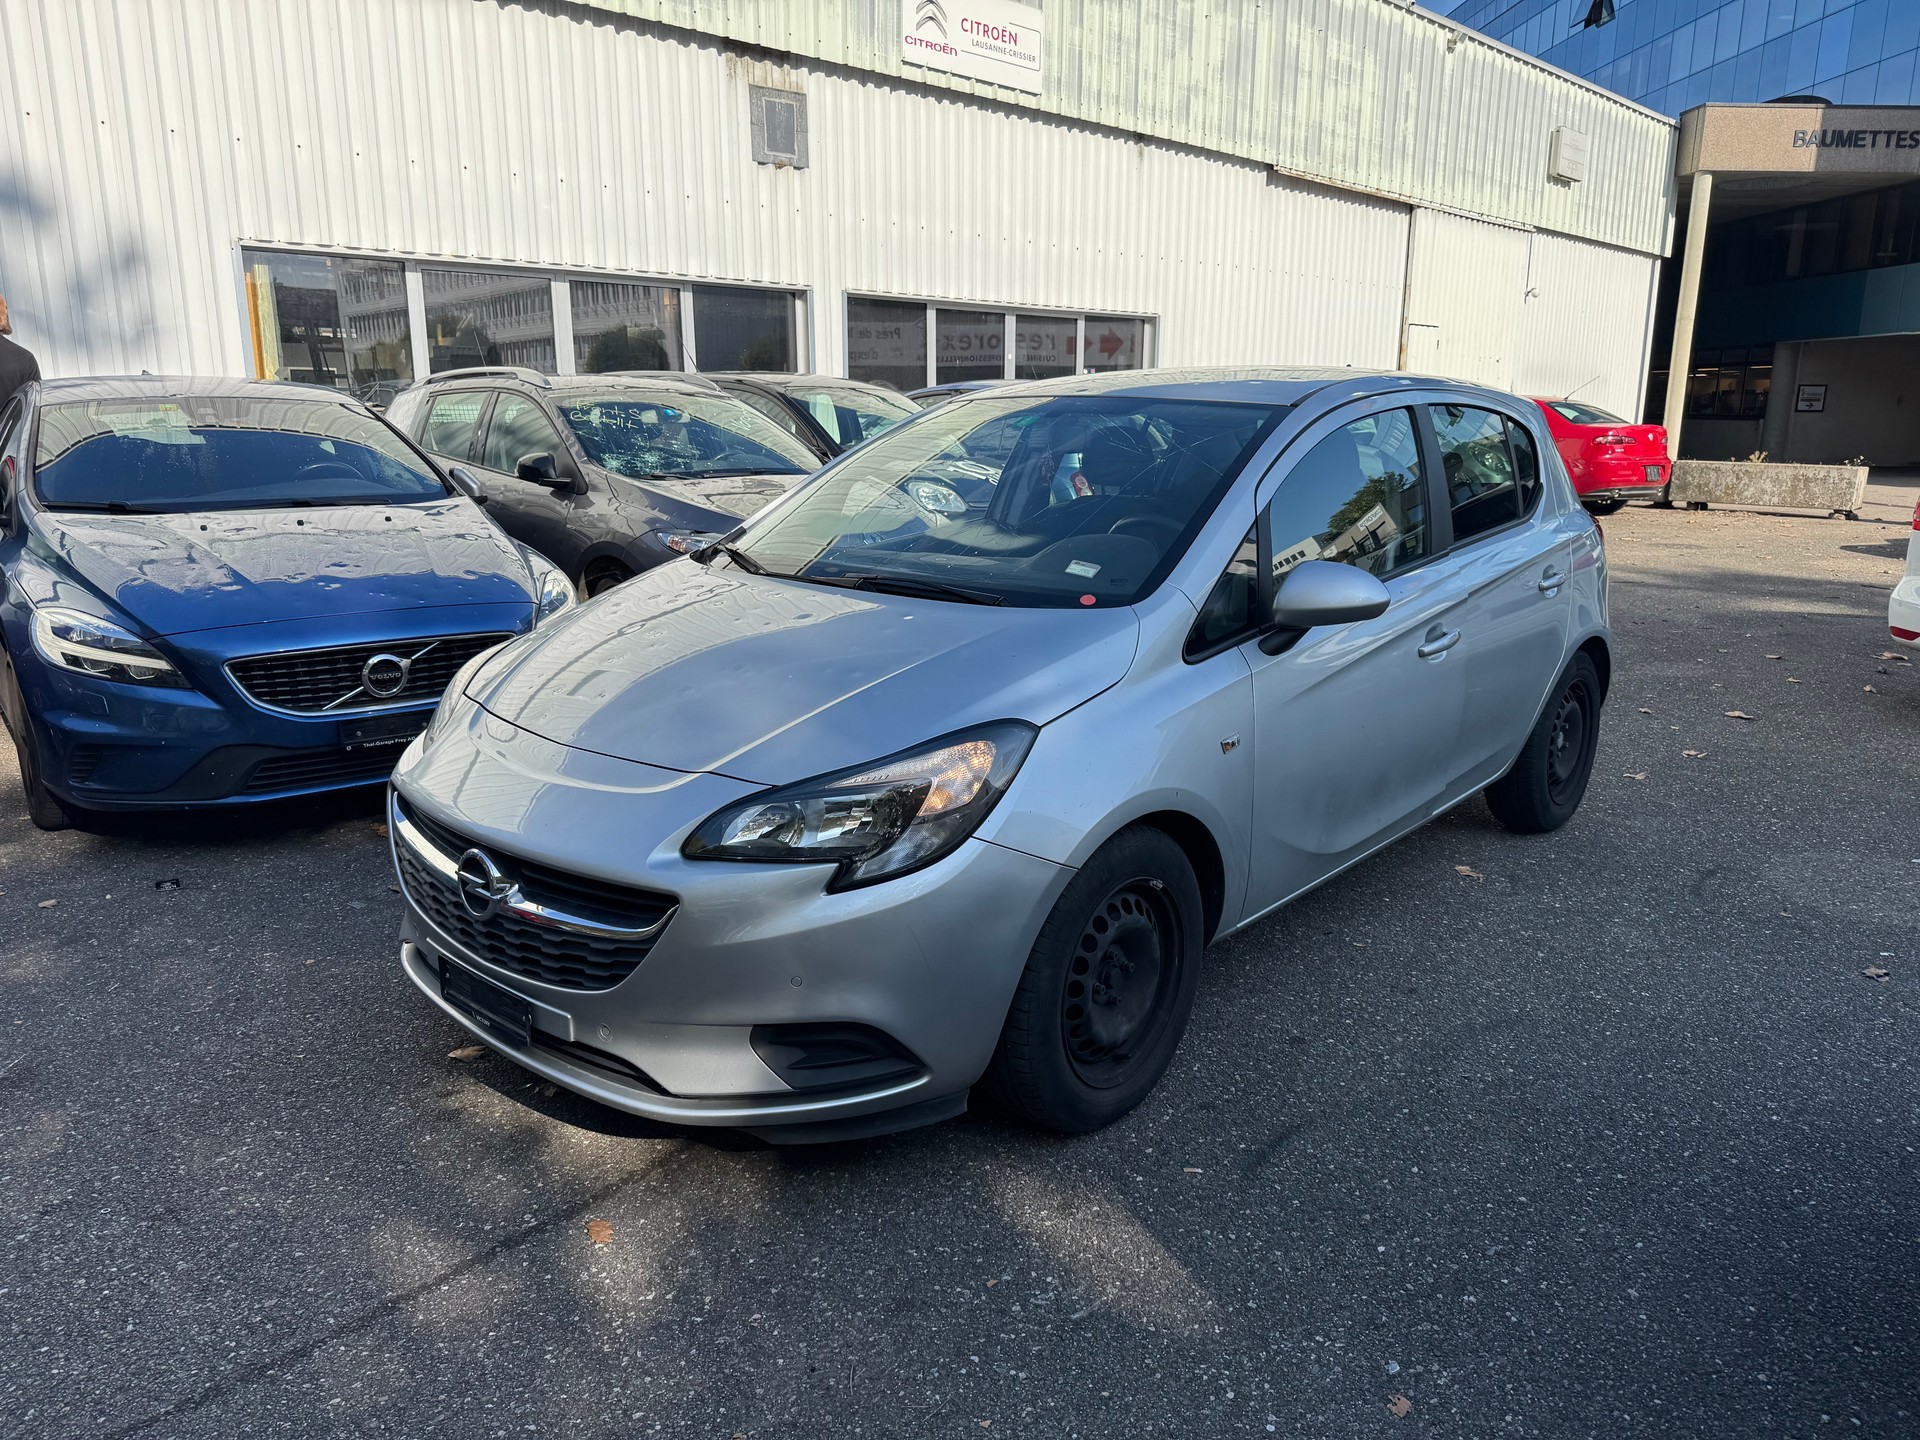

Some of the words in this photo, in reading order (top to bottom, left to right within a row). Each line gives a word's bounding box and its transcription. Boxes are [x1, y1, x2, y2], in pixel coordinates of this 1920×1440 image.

[960, 17, 1018, 47] CITROËN
[904, 35, 958, 57] CITROËN
[971, 38, 1037, 63] LAUSANNE-CRISSIER
[1792, 129, 1920, 149] BAUMETTES
[369, 672, 402, 680] VOLVO
